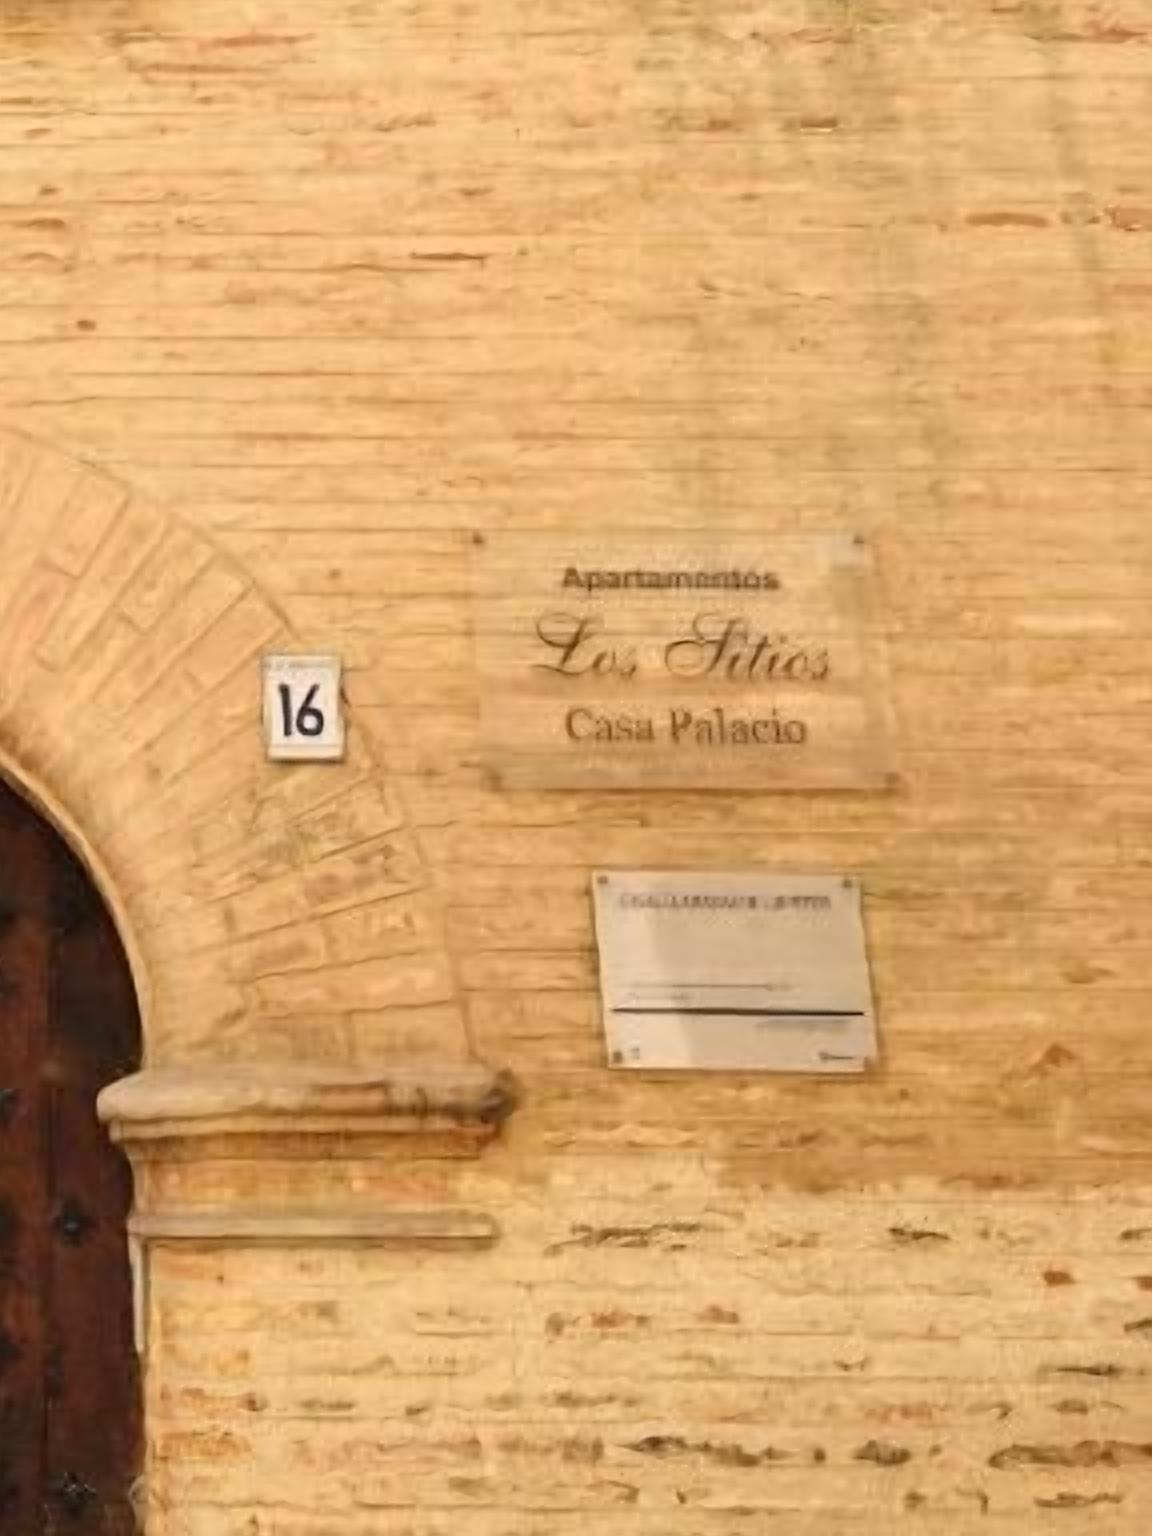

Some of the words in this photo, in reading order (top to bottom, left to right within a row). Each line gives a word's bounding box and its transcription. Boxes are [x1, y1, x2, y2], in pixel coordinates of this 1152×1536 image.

[562, 567, 782, 592] Apartamentos
[532, 613, 638, 677] Los
[664, 613, 830, 680] Sitios
[278, 683, 325, 738] 16
[565, 708, 654, 743] Casa
[669, 707, 808, 747] Palacio
